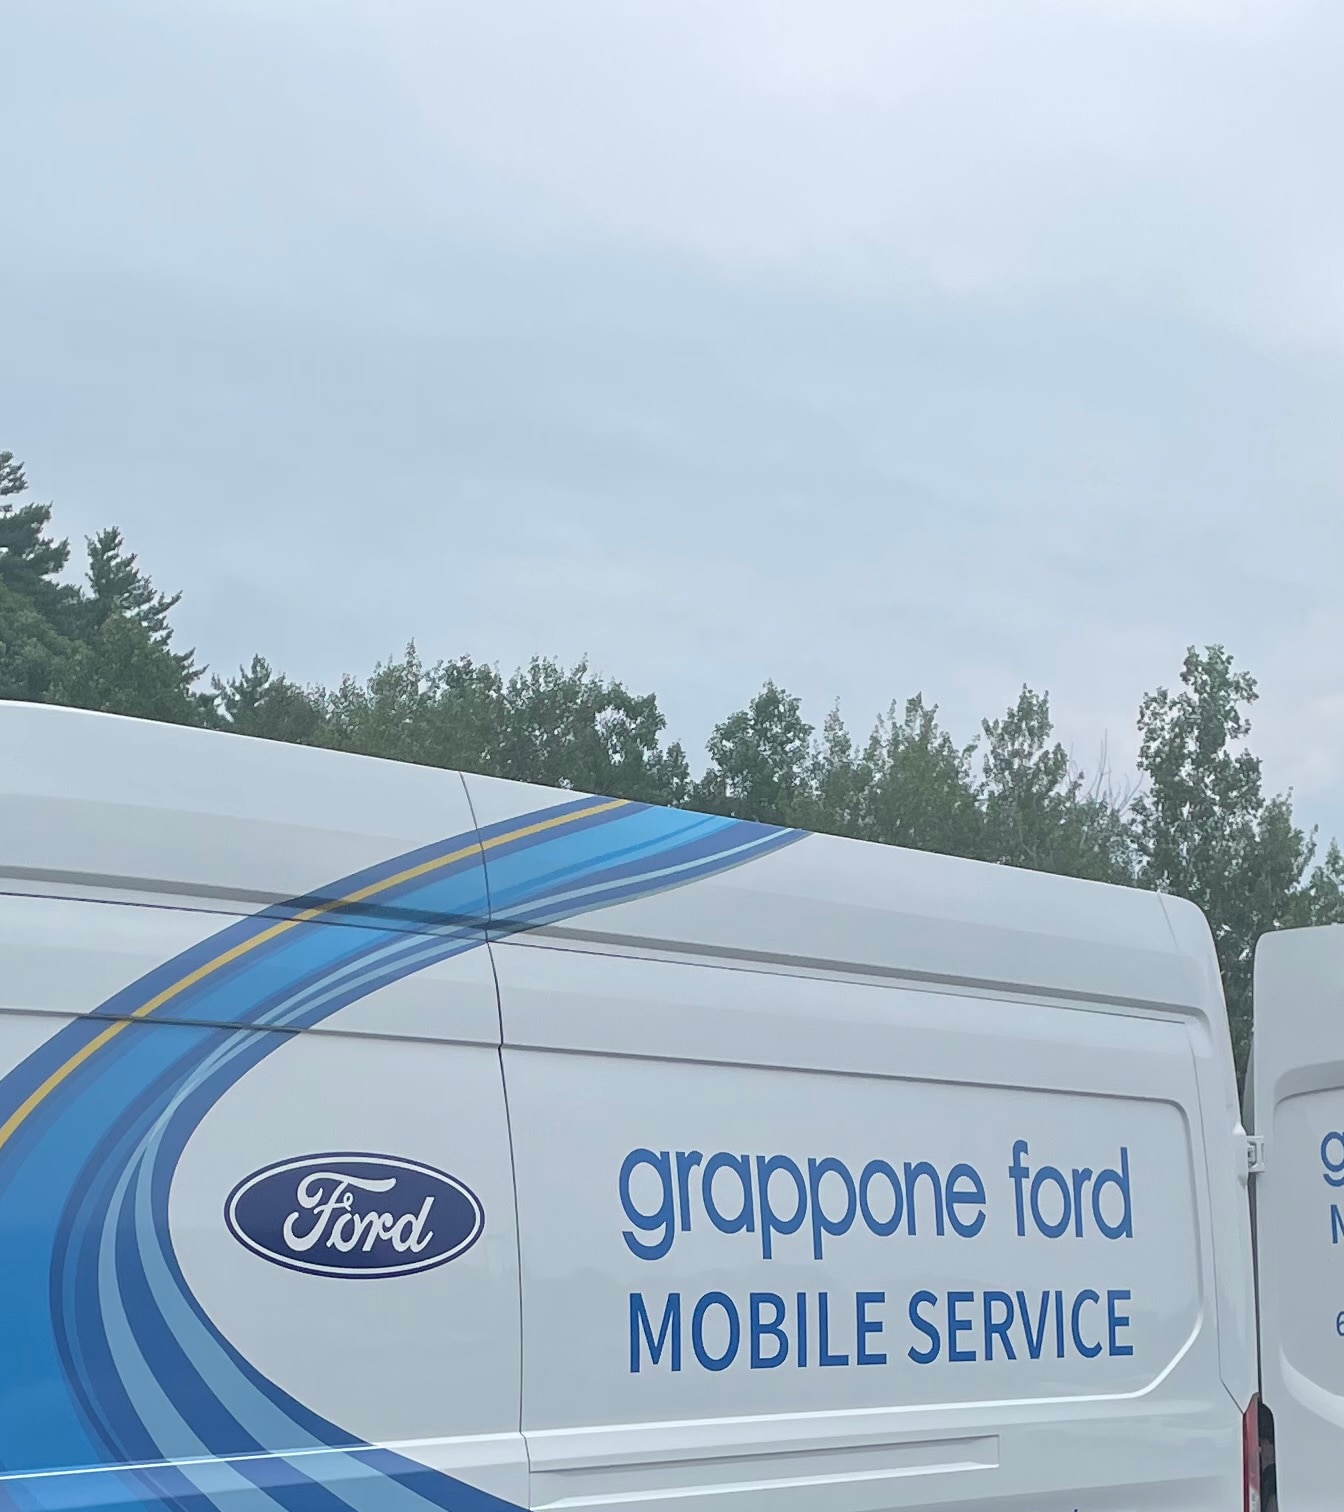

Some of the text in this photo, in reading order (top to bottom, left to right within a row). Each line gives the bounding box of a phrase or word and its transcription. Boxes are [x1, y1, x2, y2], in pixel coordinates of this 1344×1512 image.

[283, 1171, 435, 1253] Ford
[618, 1139, 1134, 1261] grappone ford
[629, 1288, 1134, 1373] MOBILE SERVICE
